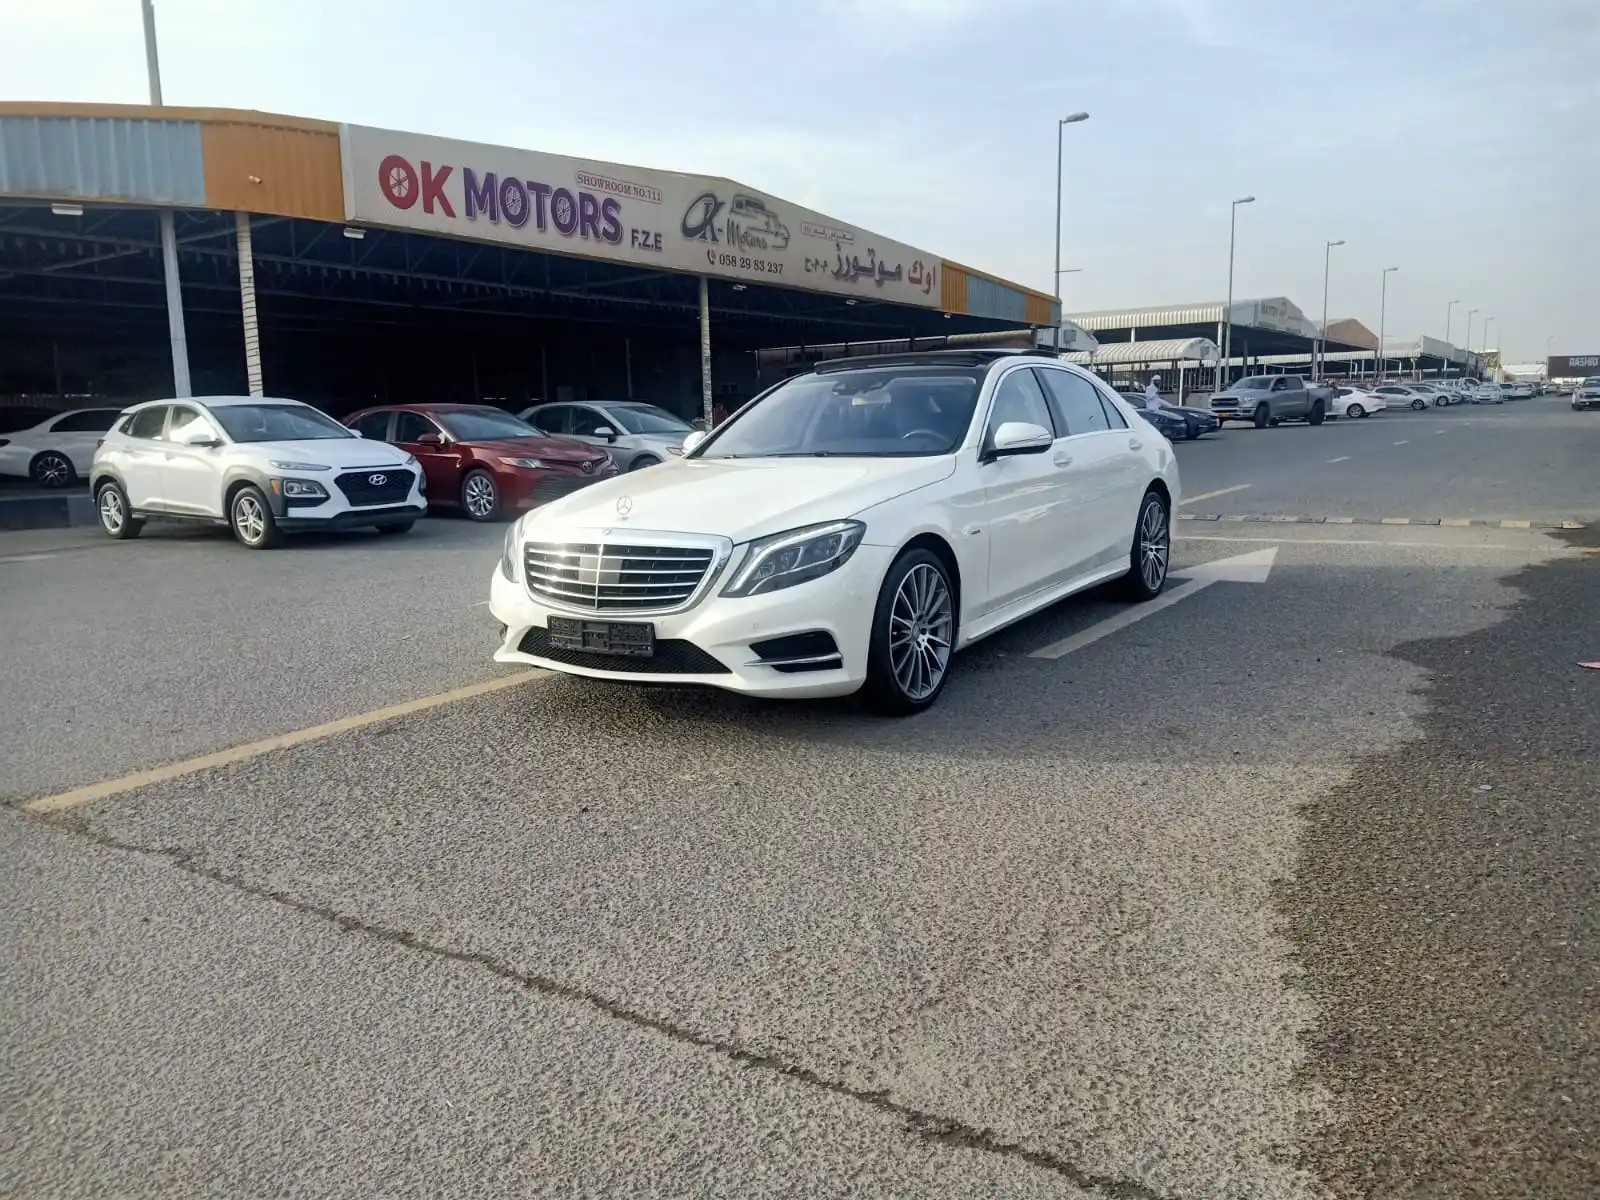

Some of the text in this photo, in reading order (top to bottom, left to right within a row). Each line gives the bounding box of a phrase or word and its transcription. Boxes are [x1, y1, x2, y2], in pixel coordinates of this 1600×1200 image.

[577, 173, 631, 195] SHOWROOM
[378, 154, 663, 251] OK MOTORS F.Z.E
[719, 254, 784, 275] 058 29 83 237
